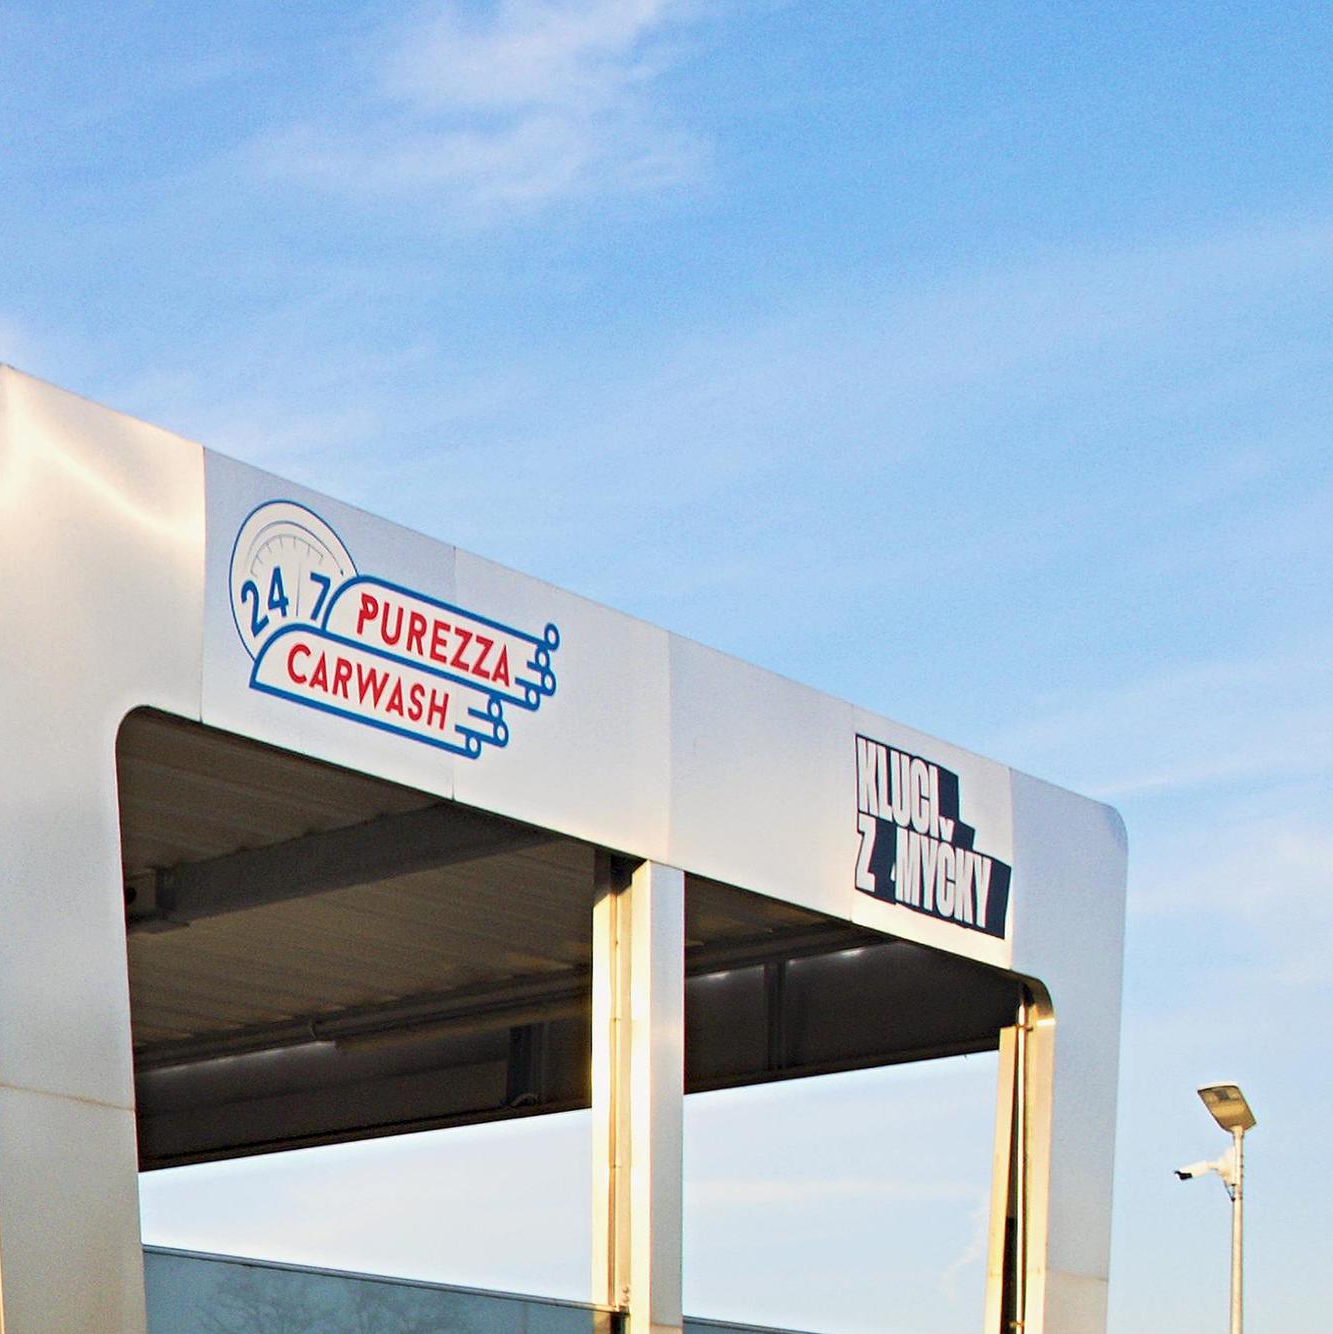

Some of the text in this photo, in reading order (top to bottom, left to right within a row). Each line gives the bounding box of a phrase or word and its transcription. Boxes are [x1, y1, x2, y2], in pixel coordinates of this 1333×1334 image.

[240, 565, 331, 637] 24 7
[356, 592, 511, 688] PUREZZA
[286, 644, 450, 731] CARWASH
